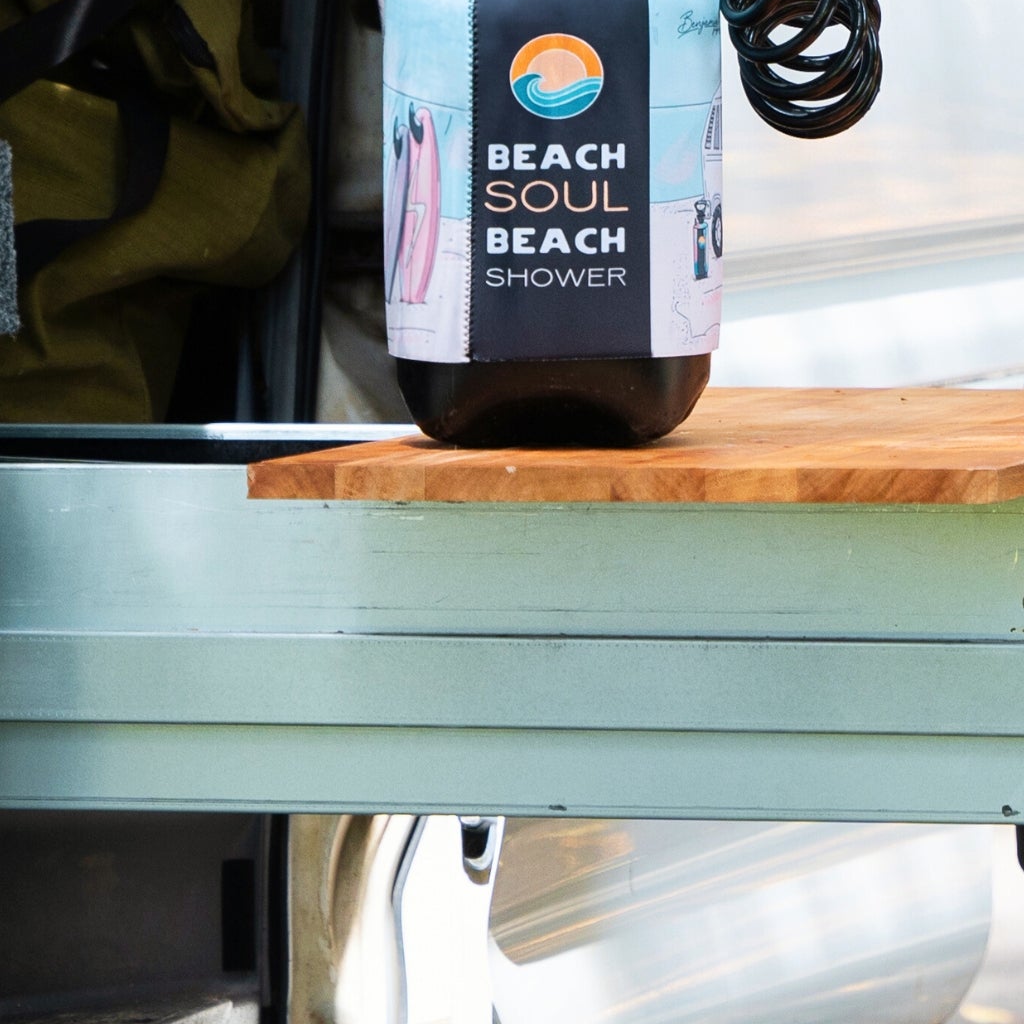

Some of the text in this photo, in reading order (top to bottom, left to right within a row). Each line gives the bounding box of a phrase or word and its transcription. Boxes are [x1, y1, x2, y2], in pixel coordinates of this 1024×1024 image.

[487, 143, 626, 171] BEACH
[484, 180, 629, 212] SOUL
[486, 227, 626, 254] BEACH
[485, 268, 627, 287] SHOWER
